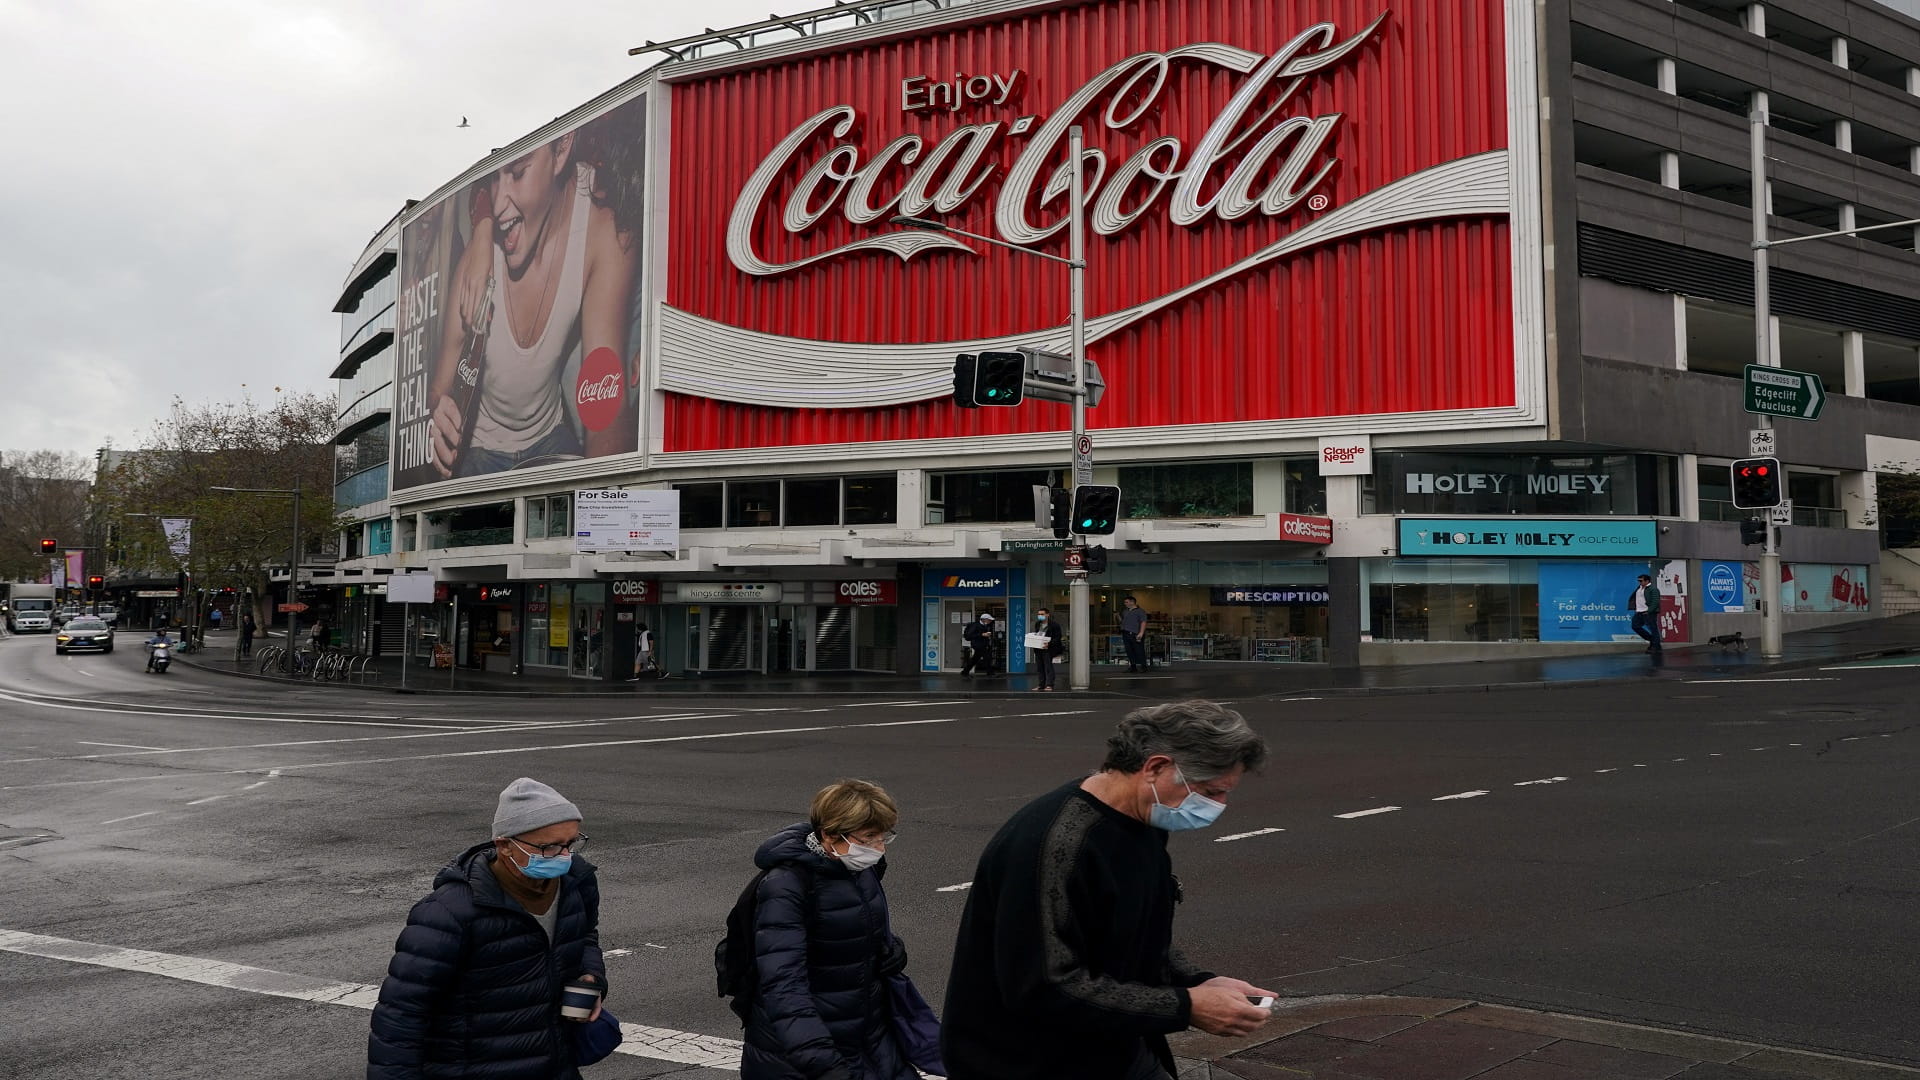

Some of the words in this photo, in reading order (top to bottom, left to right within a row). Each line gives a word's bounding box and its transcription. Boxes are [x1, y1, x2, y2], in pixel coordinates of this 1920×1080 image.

[901, 69, 1020, 112] Enjoy
[726, 8, 1390, 277] Coca-Cola
[403, 271, 439, 331] TASTE
[402, 326, 425, 378] THE
[1753, 373, 1770, 382] KINGS
[1771, 375, 1790, 385] CROSS
[1792, 378, 1800, 386] RD
[577, 372, 622, 405] Coca-Cola
[1754, 386, 1797, 401] Edgecliff
[400, 372, 430, 424] REAL
[1754, 398, 1797, 413] Vaucluse
[399, 417, 435, 471] THING
[1323, 446, 1365, 455] Claude
[1752, 445, 1773, 454] LANE
[1324, 453, 1354, 463] Neon
[1406, 472, 1508, 495] HOLEY
[1527, 473, 1610, 495] MOLEY
[578, 491, 599, 499] For
[601, 491, 628, 499] Sale
[1284, 518, 1312, 536] coles
[1015, 541, 1053, 550] Darlinghurst
[1432, 532, 1508, 545] HOLEY
[1515, 532, 1575, 546] MOLEY
[1578, 536, 1608, 544] GOLF
[1610, 536, 1639, 544] CLUB
[612, 580, 645, 595] coles
[840, 580, 878, 596] coles
[1710, 577, 1734, 586] ALWAYS
[1558, 603, 1578, 611] For
[1580, 602, 1616, 611] advice
[1558, 614, 1579, 623] you
[1604, 614, 1632, 622] trust
[1015, 603, 1024, 667] PHARMACY
